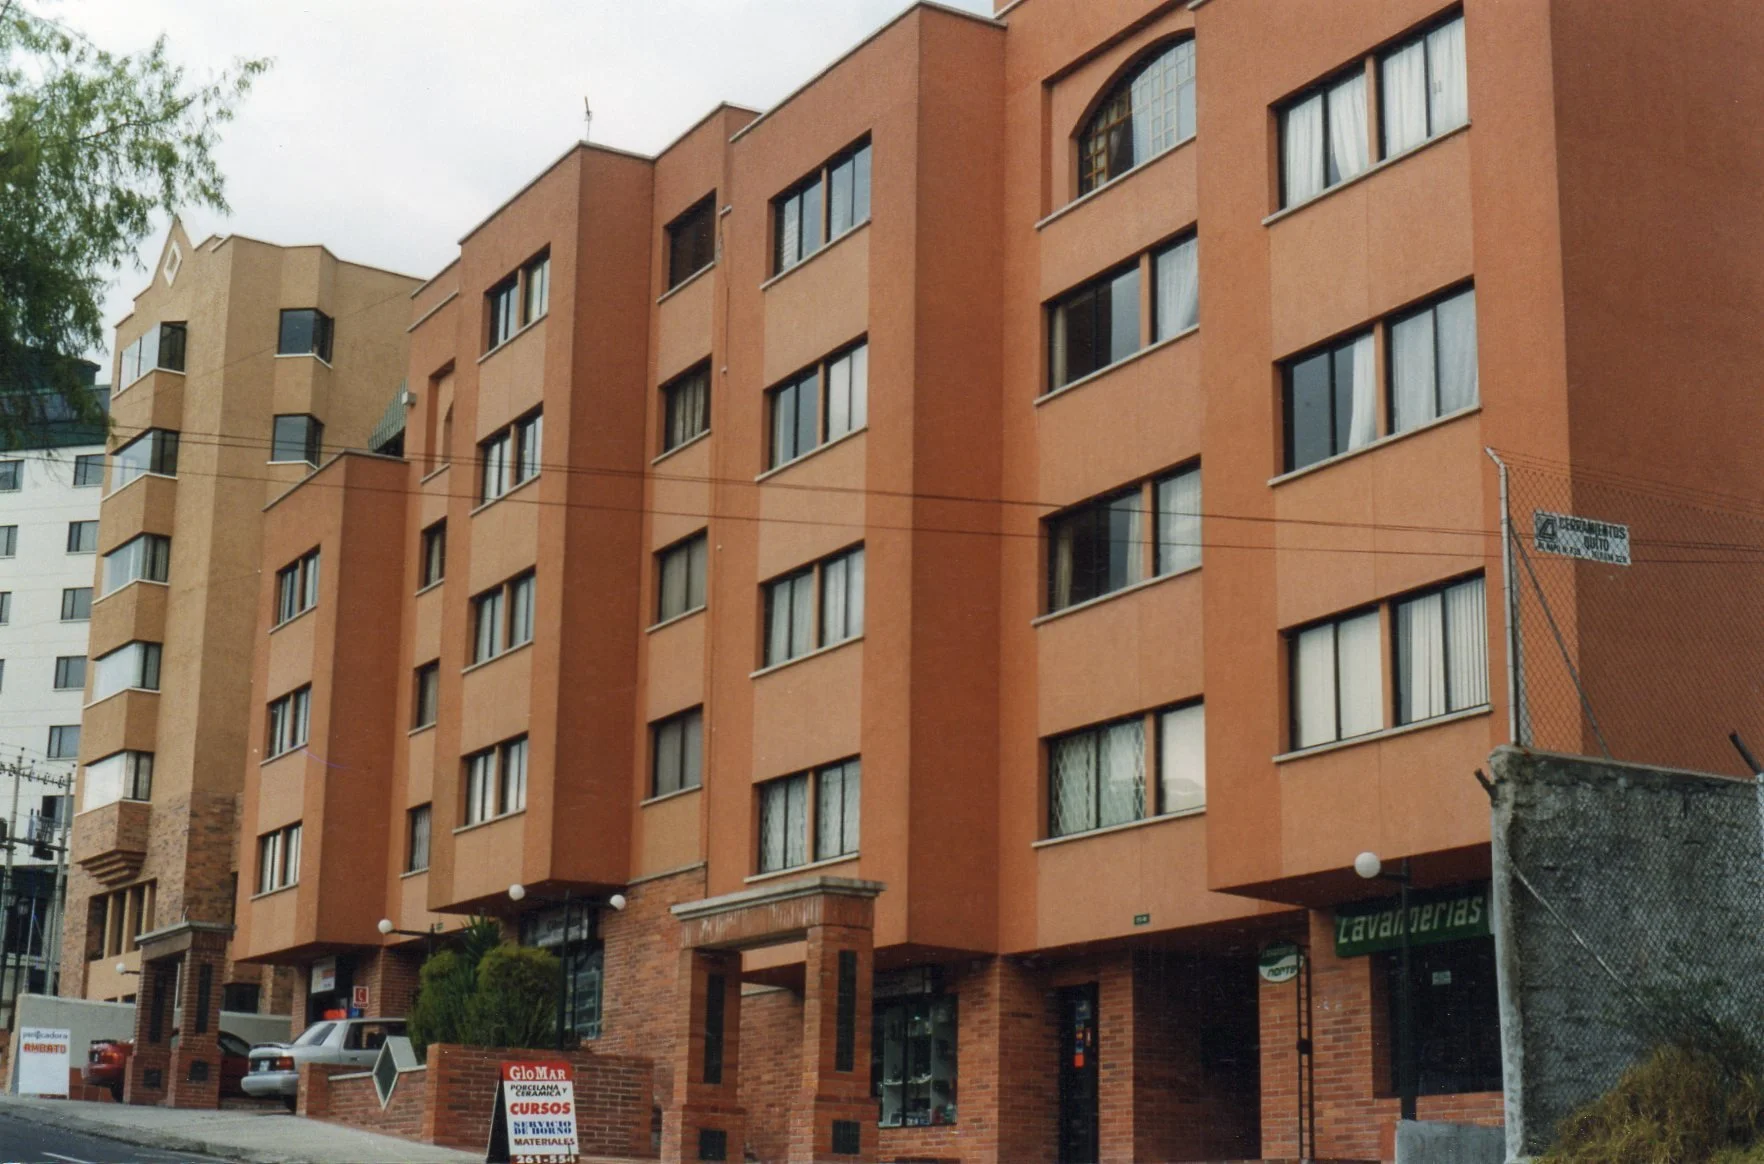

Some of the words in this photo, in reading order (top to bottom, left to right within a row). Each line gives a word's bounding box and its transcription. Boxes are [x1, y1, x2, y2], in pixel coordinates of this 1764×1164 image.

[1584, 535, 1609, 551] QUITO
[510, 1102, 571, 1115] CURSOS
[532, 1127, 571, 1135] HORNO
[514, 1138, 575, 1146] MATERIALES
